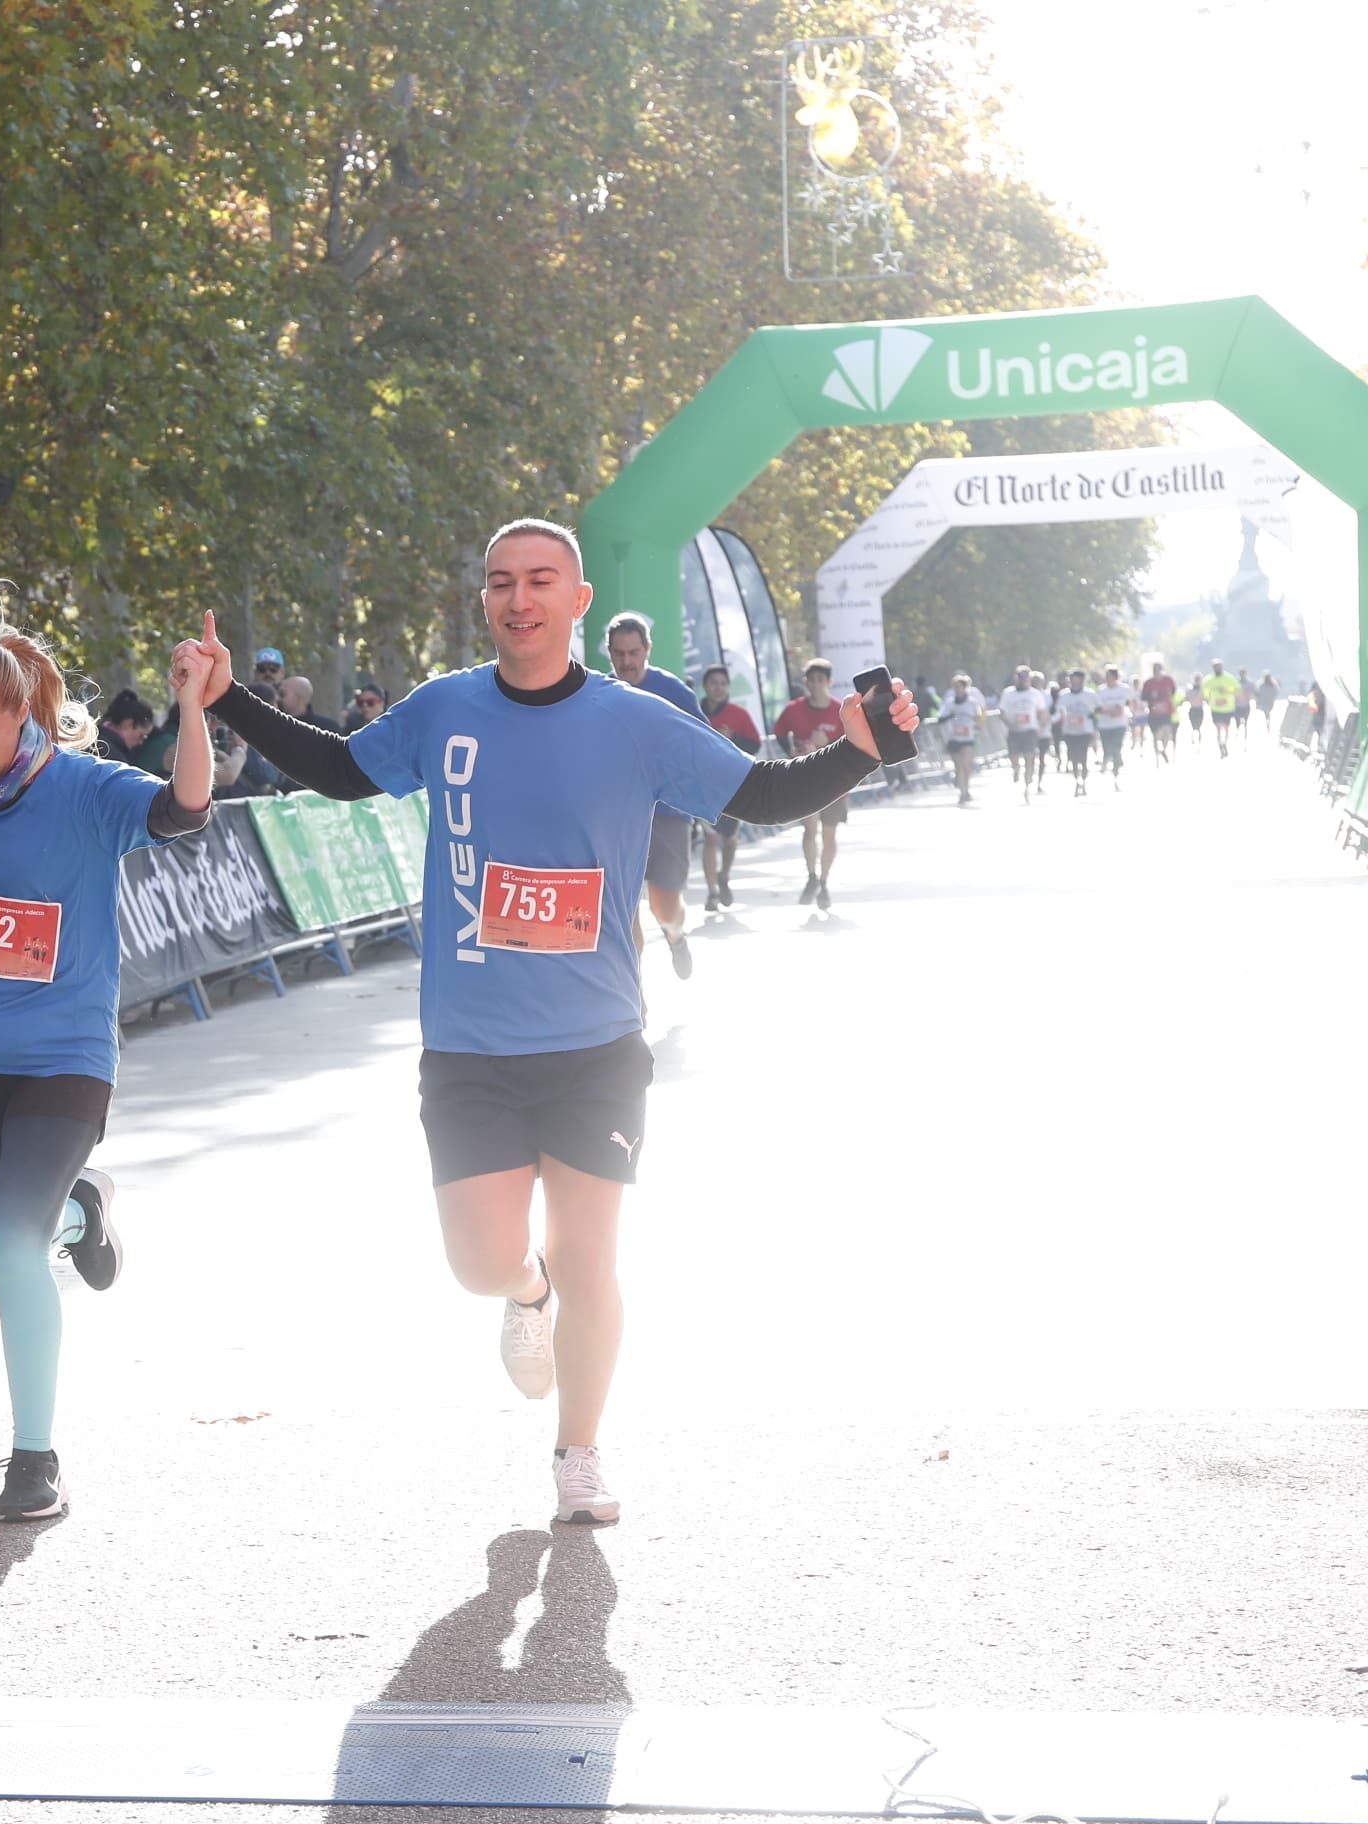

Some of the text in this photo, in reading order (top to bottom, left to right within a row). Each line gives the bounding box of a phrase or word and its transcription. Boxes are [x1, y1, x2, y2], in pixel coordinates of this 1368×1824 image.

[947, 335, 1188, 399] Unicaja
[954, 462, 1226, 507] El Norte de Castilla
[444, 735, 485, 964] IVECO
[500, 882, 557, 922] 753
